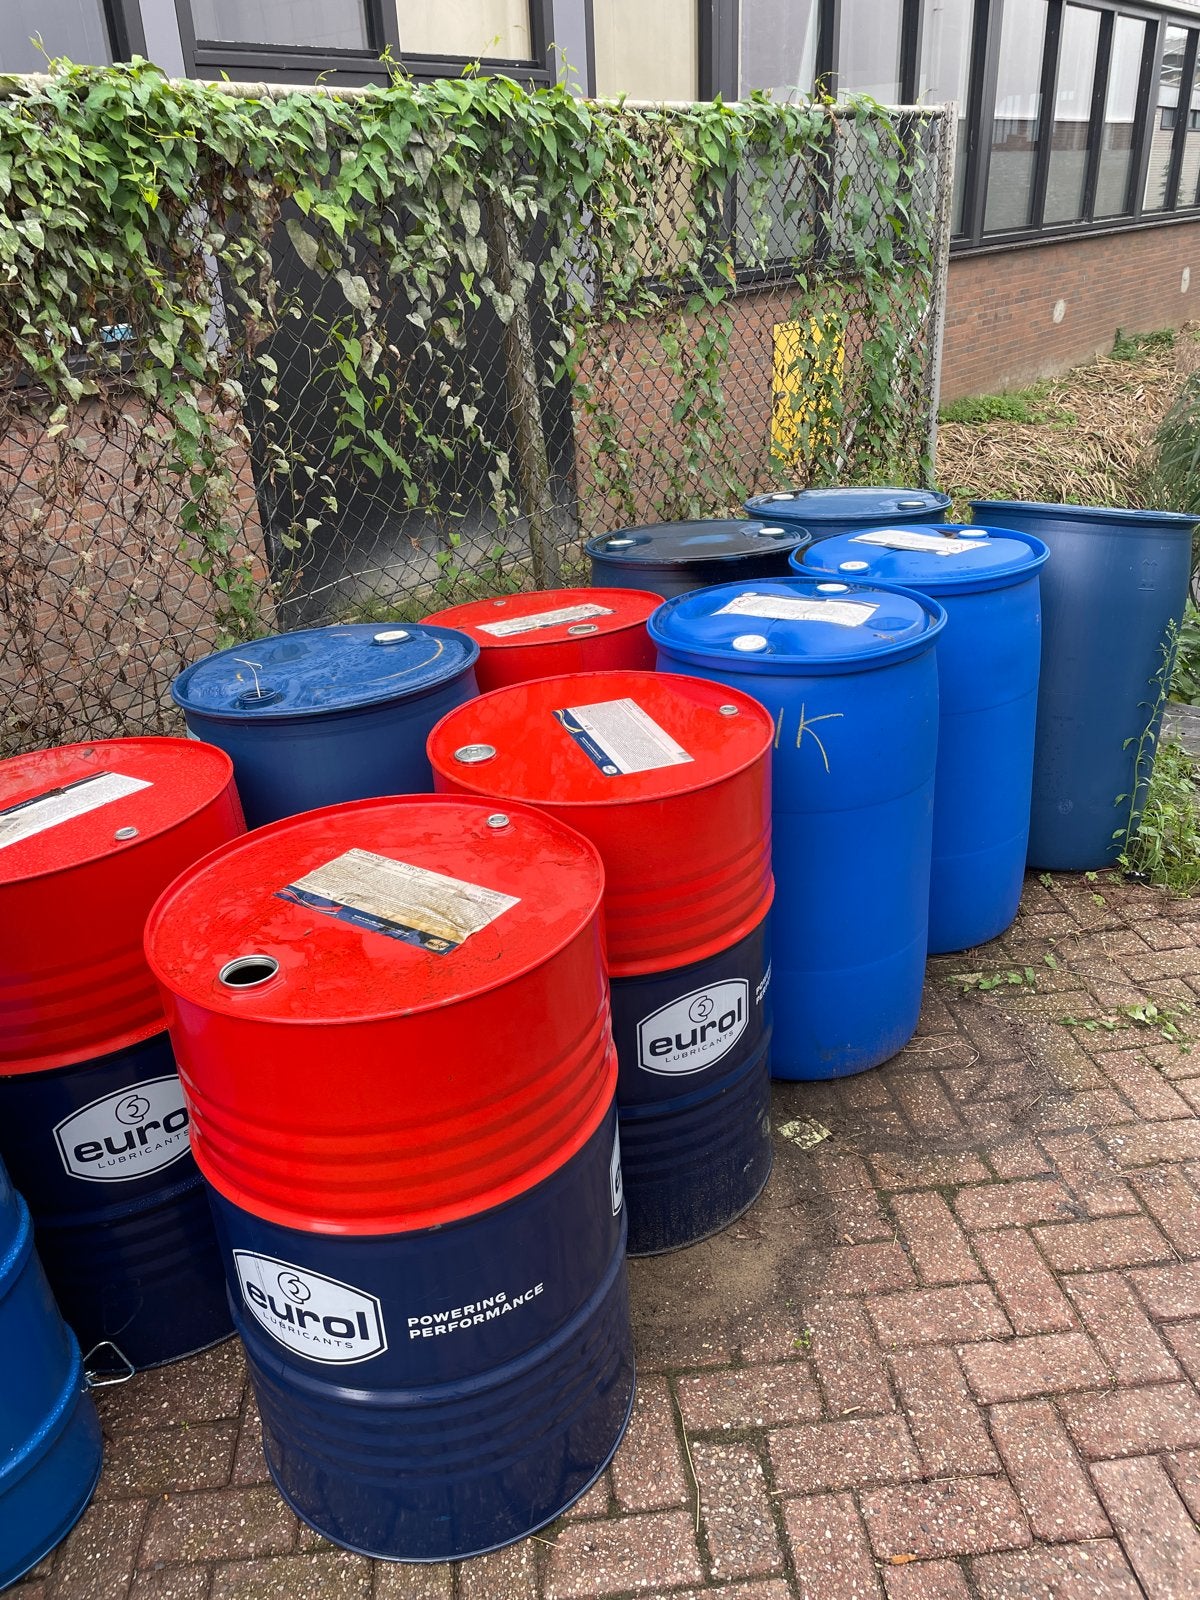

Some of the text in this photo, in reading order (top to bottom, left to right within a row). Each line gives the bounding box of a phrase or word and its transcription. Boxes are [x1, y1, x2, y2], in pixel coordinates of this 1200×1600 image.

[649, 997, 742, 1057] eurol
[665, 1030, 734, 1063] LUBRICANTS
[73, 1107, 190, 1163] euro
[246, 1280, 370, 1341] eurol
[262, 1311, 354, 1349] LUBRICANTS
[407, 1291, 507, 1327] POWERING
[409, 1282, 545, 1339] PERFORMANCE
